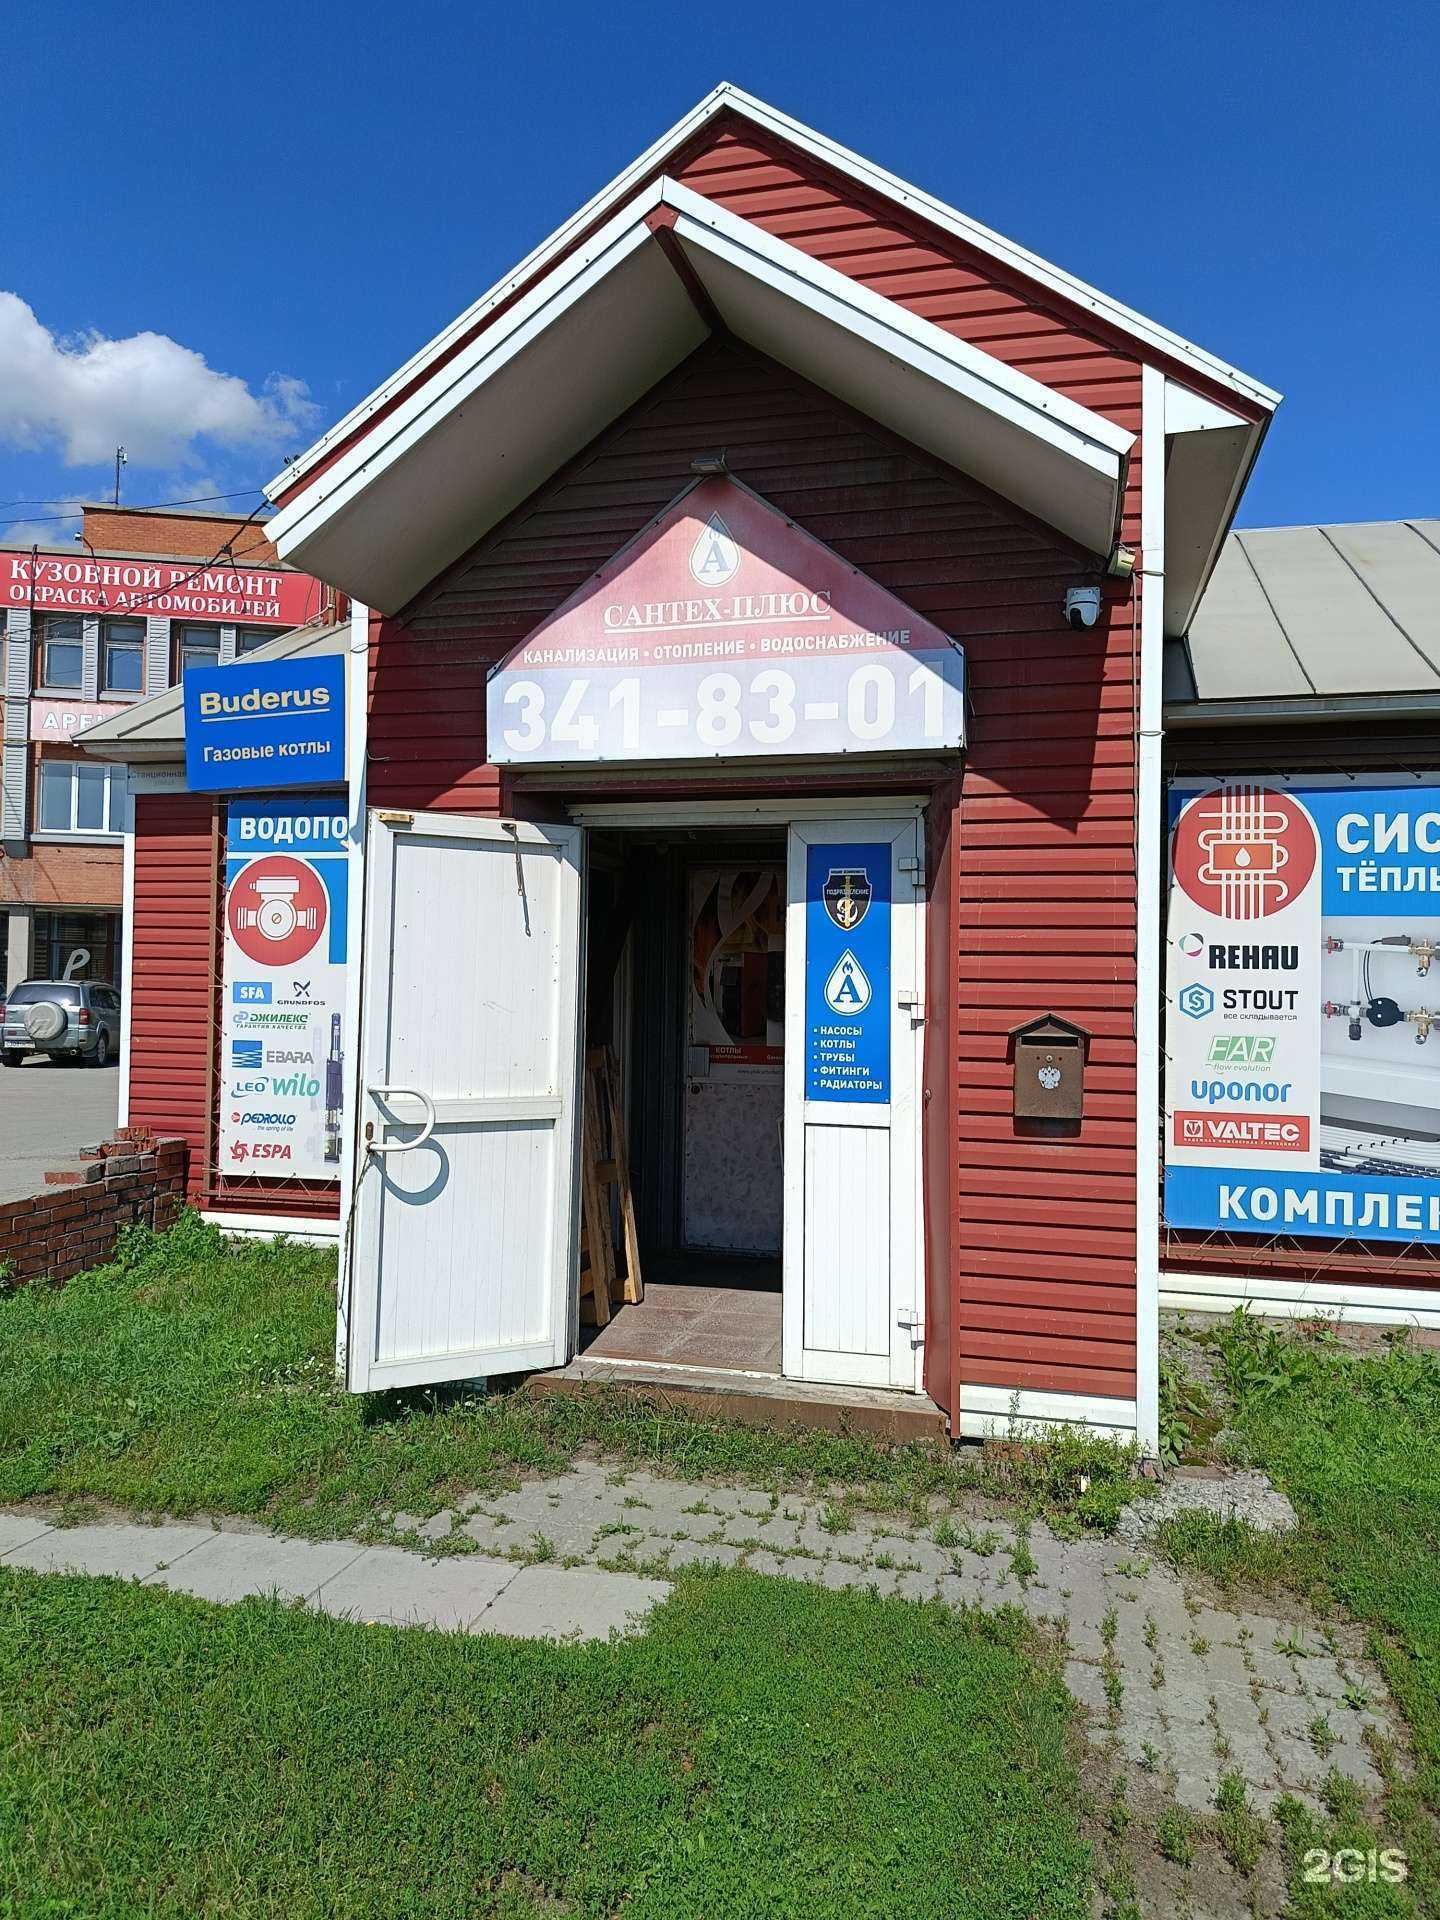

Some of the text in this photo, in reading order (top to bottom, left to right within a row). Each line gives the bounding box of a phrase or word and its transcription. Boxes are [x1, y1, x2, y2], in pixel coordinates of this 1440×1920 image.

[10, 559, 283, 598] КУЗОВНОЙ РЕМОНТ
[9, 584, 281, 618] ОКРАСКА АВТОМОБИЛЕЙ
[603, 590, 832, 628] САНТЕХ-ПЛЮС
[523, 629, 911, 665] КАНАЛИЗАЦИЯ ОТОПЛЕНИЕ ВОДОСНАБЖЕНИЕ
[200, 687, 330, 715] Buderus
[502, 662, 946, 752] 341-83-01
[42, 712, 105, 730] АРЕ
[203, 741, 331, 762] Газовые котлы
[1208, 944, 1299, 969] REHAU
[239, 987, 265, 999] SFA
[1223, 989, 1299, 1010] STOUT
[1239, 1013, 1298, 1021] складывается
[820, 1026, 862, 1036] НАСОСЫ
[820, 1039, 856, 1049] КОТЛЫ
[1208, 1036, 1275, 1062] FAR
[266, 1050, 315, 1064] EBARA
[820, 1052, 855, 1063] ТРУБЫ
[820, 1065, 870, 1076] ФИТИНГИ
[236, 1073, 320, 1096] LEO wilo
[820, 1079, 883, 1090] РАДИАТОРЫ
[1191, 1080, 1292, 1104] uponor
[1206, 1120, 1300, 1142] VALTEC
[252, 1144, 292, 1159] ESPA
